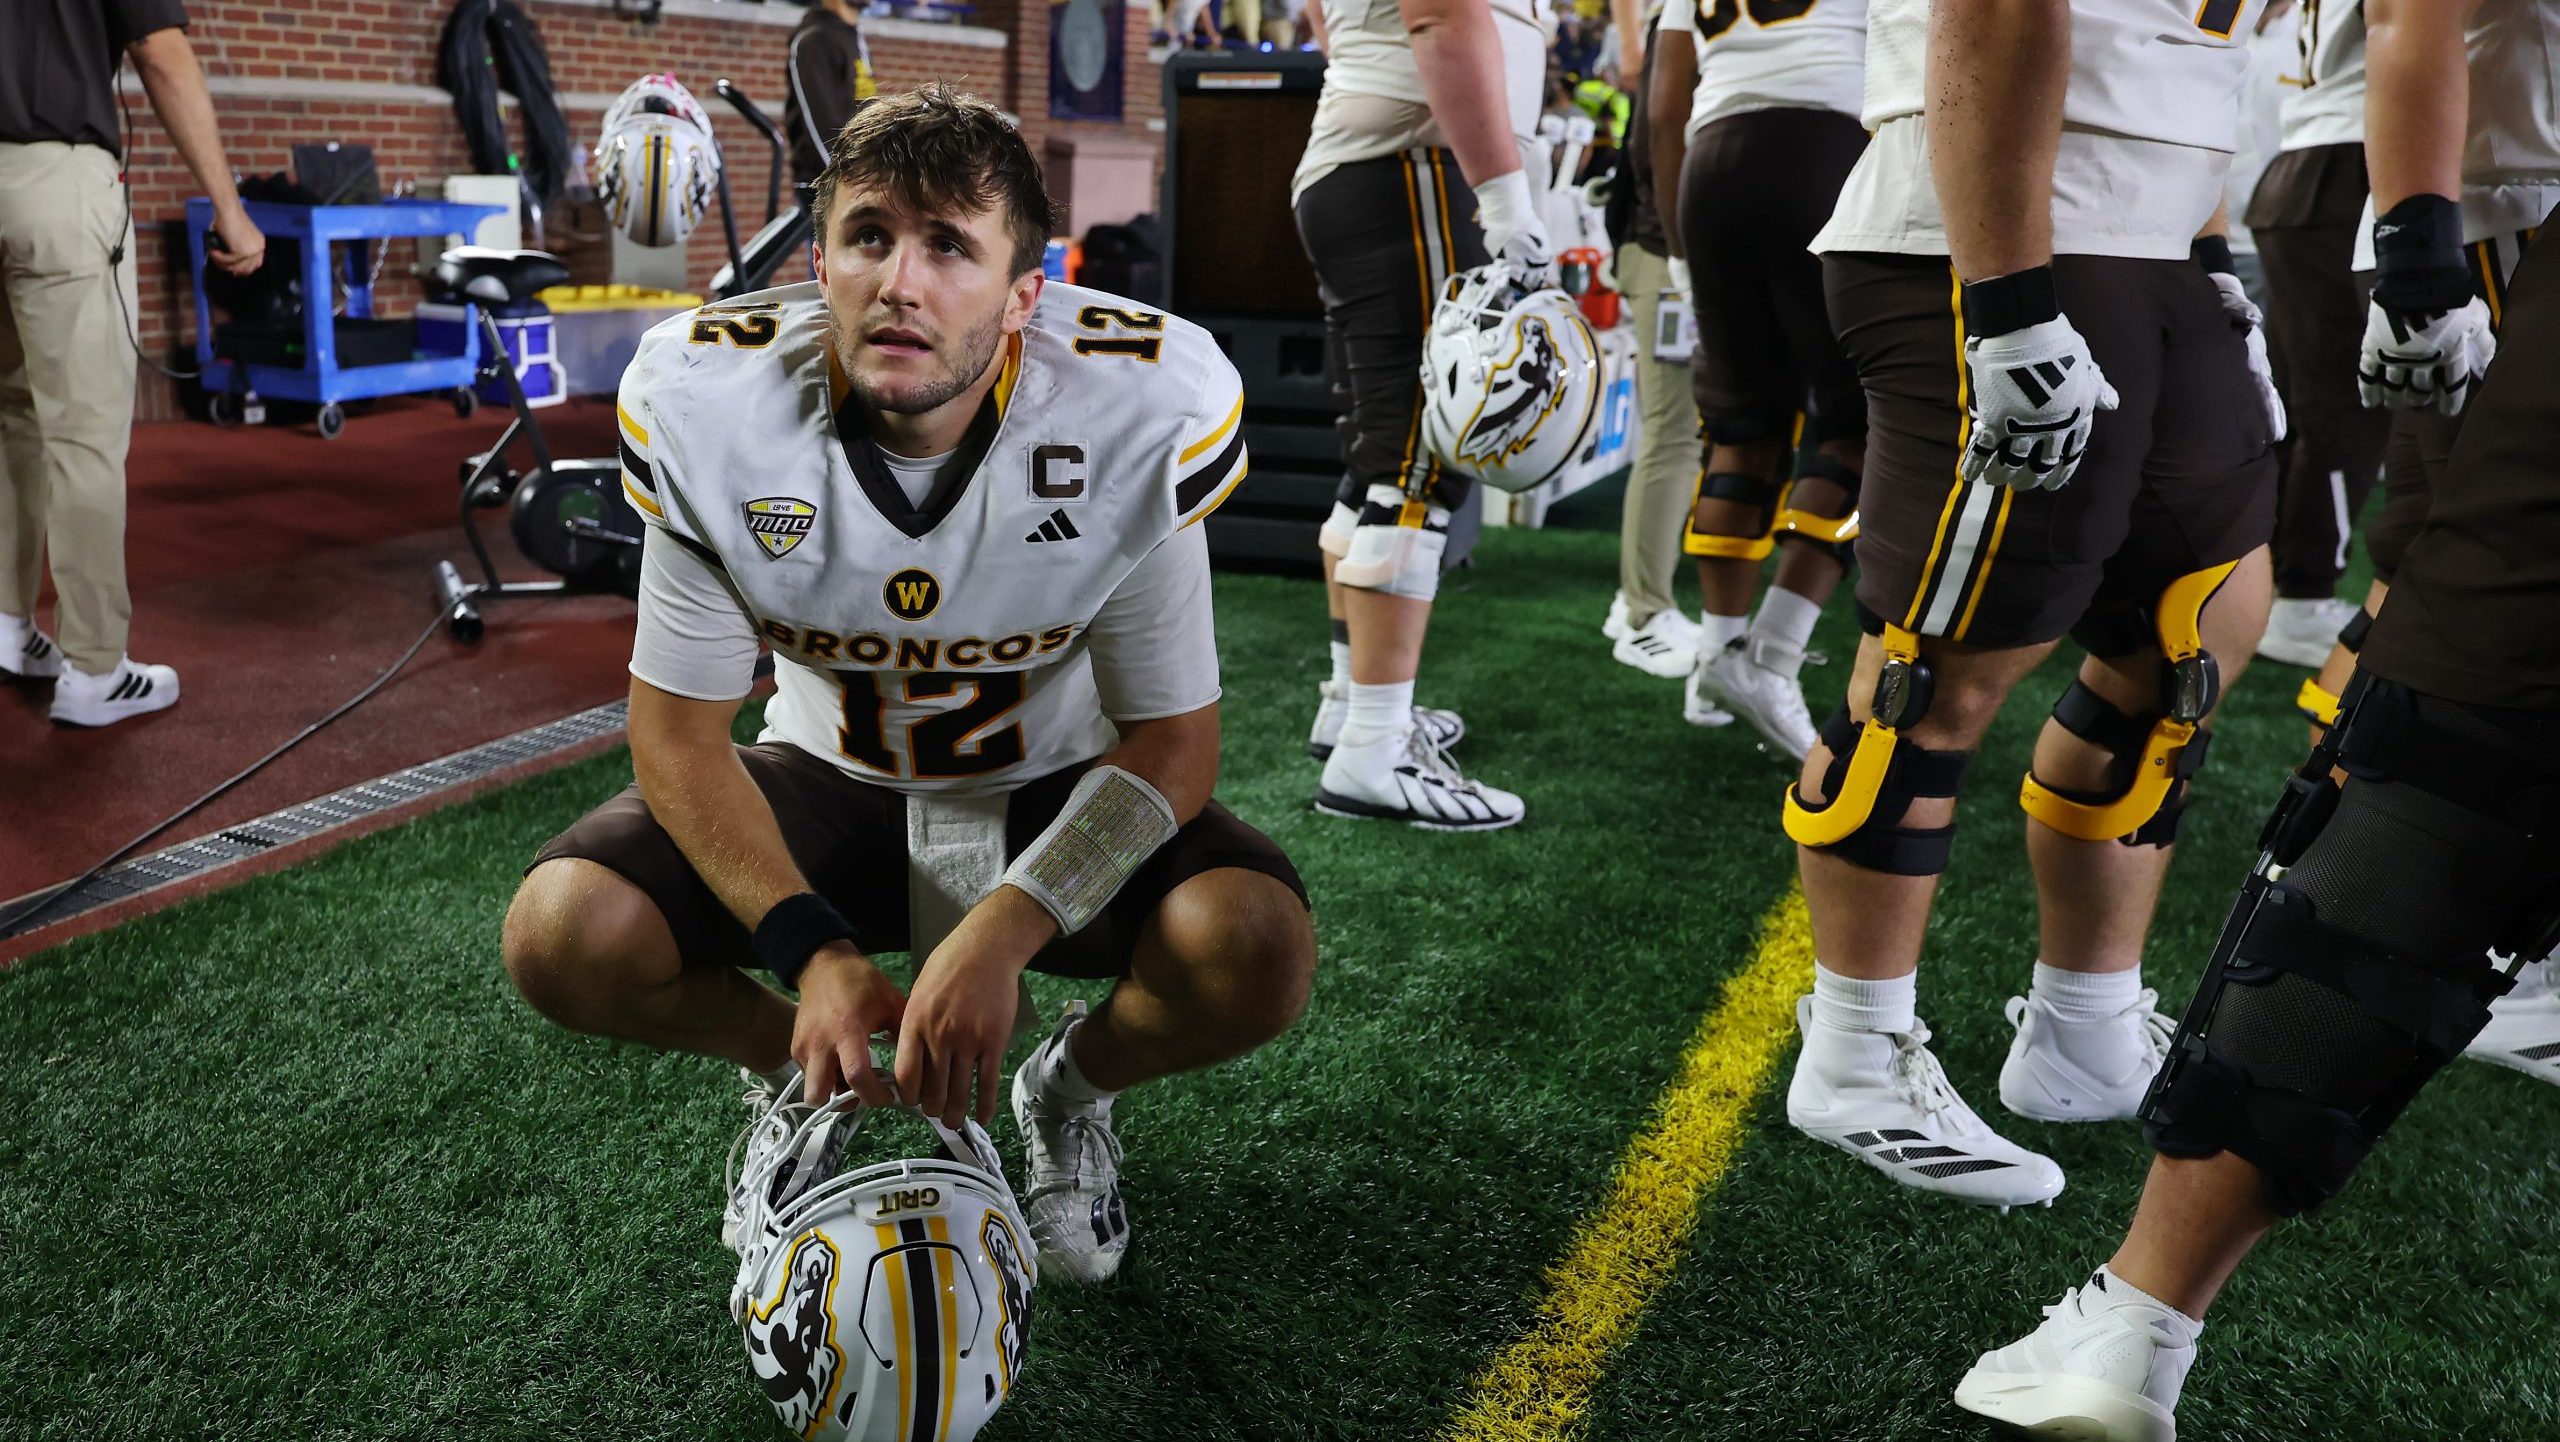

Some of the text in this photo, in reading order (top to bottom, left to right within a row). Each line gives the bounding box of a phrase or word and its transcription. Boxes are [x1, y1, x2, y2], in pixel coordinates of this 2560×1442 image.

[688, 303, 782, 349] 12
[1071, 305, 1166, 363] 12
[1032, 445, 1084, 498] C
[750, 514, 812, 533] MAC
[772, 504, 792, 512] 1946
[896, 581, 931, 610] W
[761, 618, 1084, 670] BRONCOS
[835, 669, 1026, 779] 12
[876, 1187, 941, 1216] GRIT
